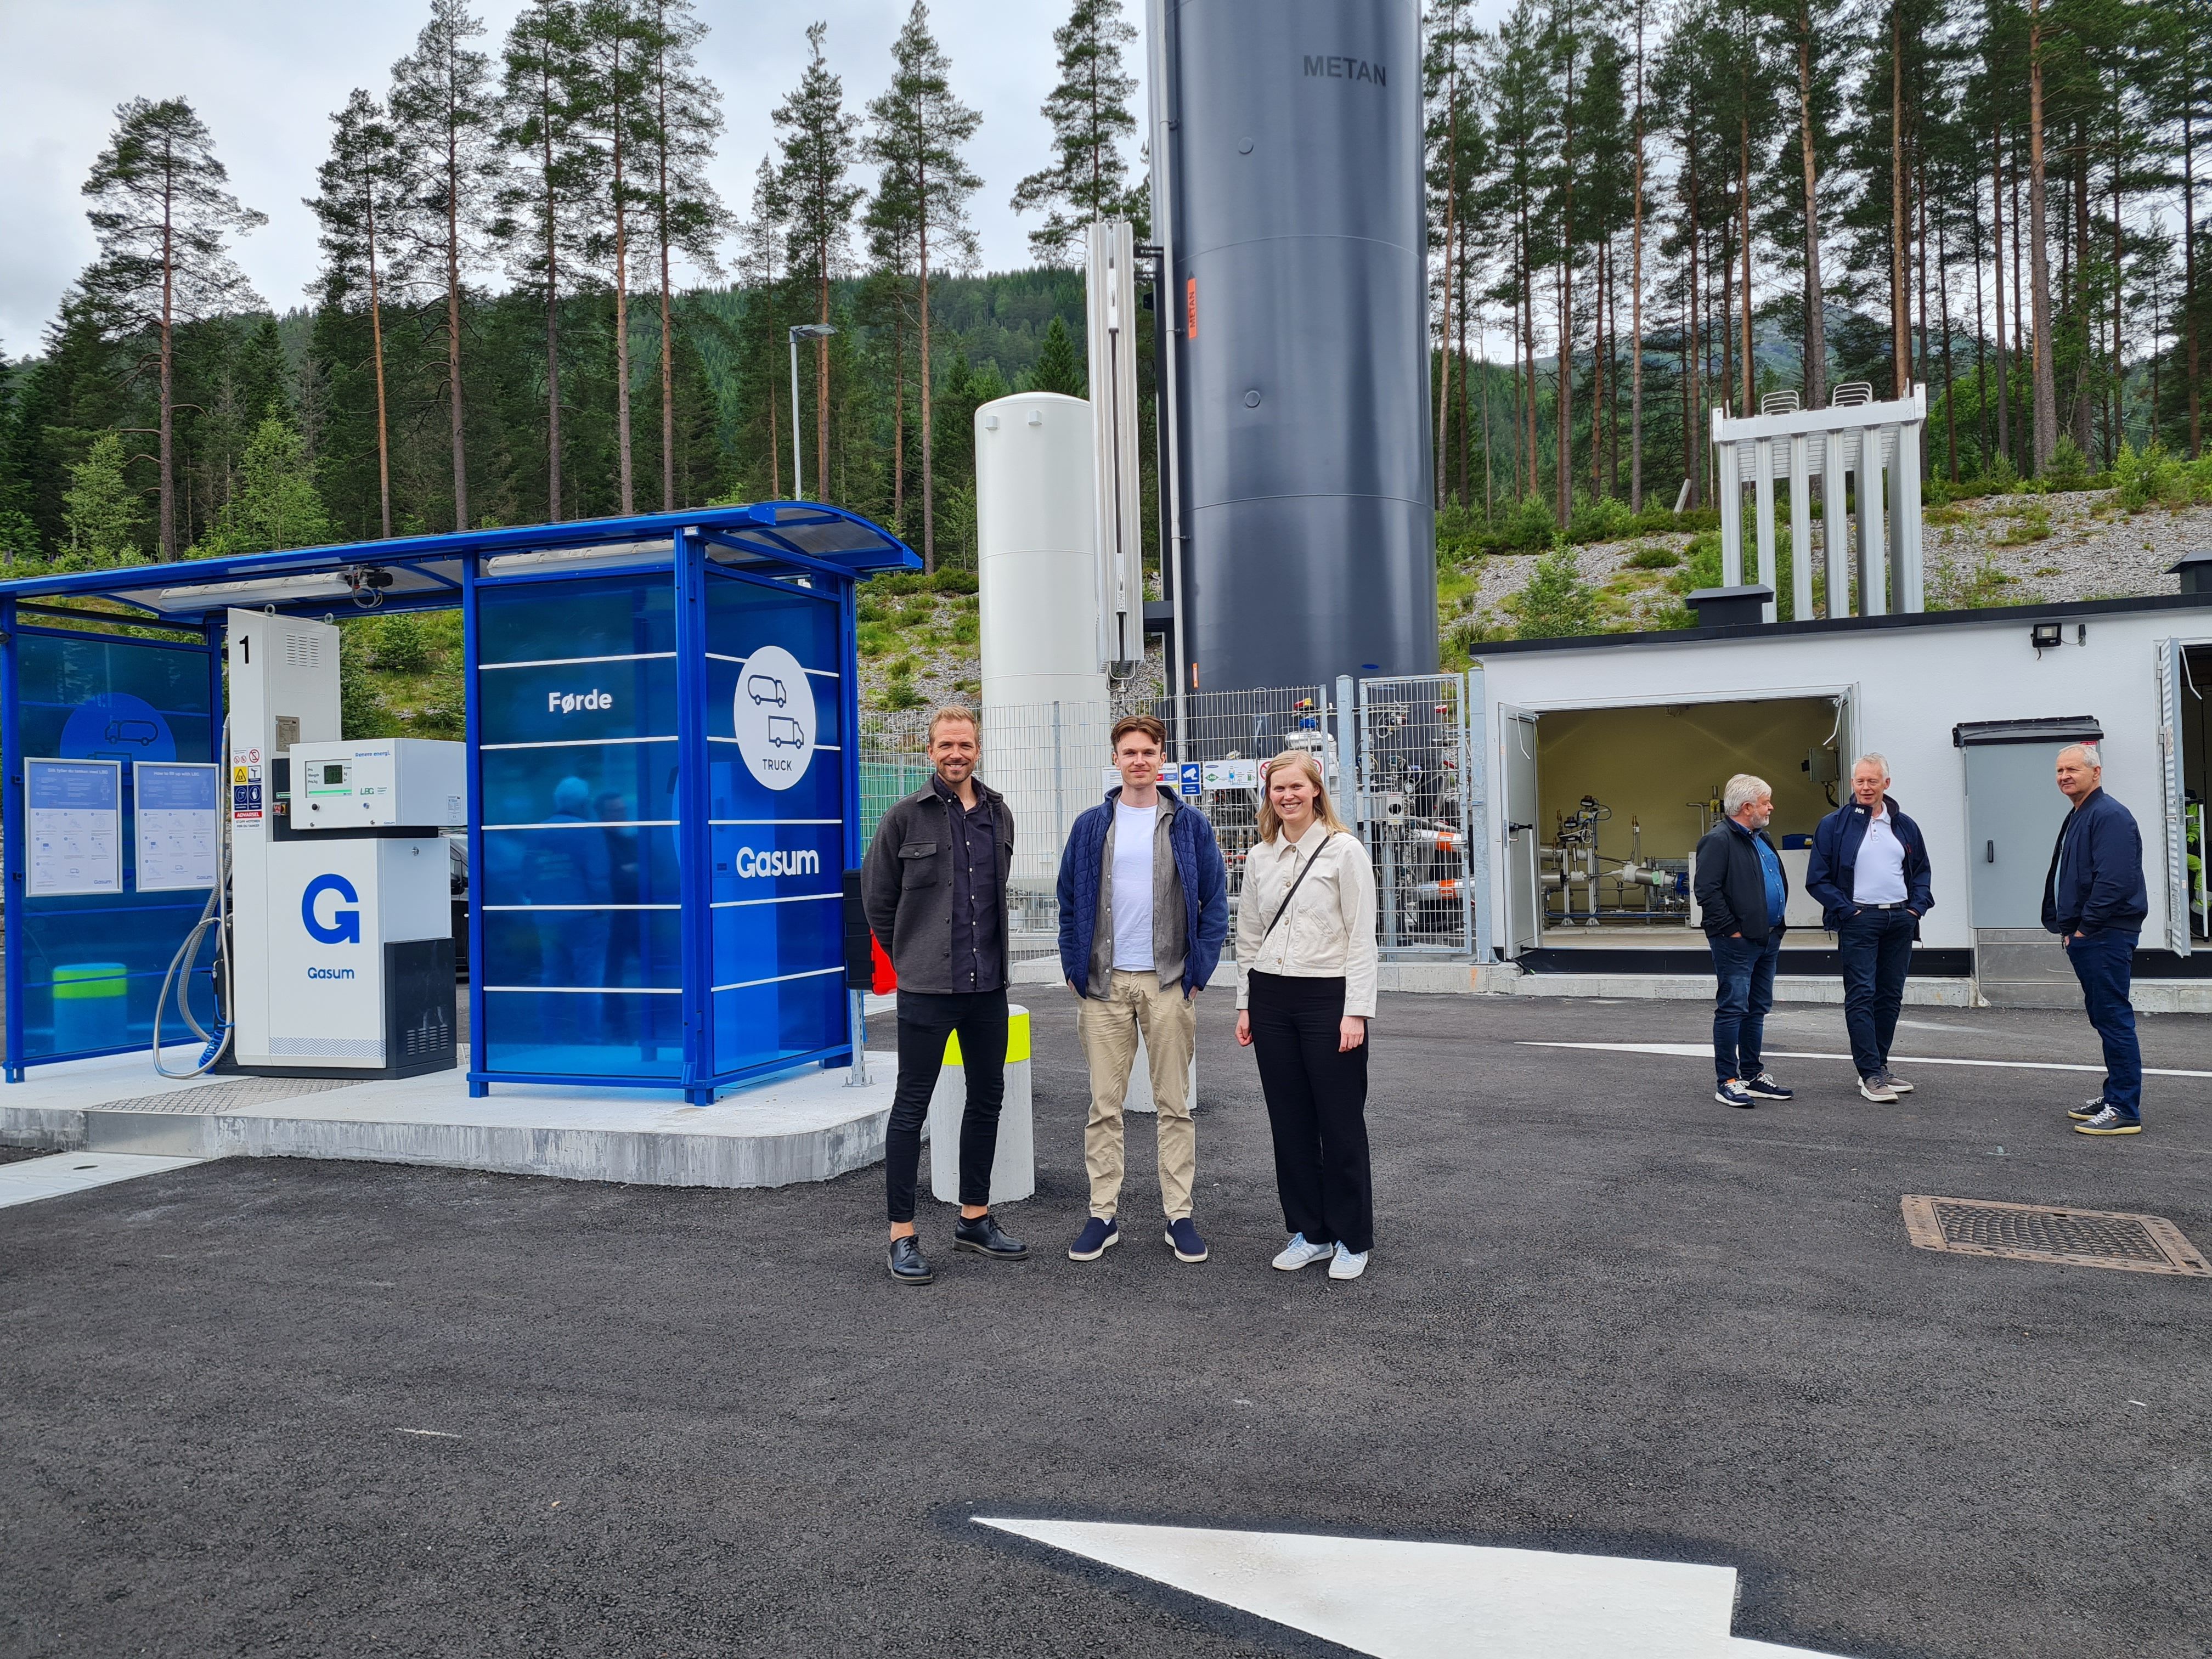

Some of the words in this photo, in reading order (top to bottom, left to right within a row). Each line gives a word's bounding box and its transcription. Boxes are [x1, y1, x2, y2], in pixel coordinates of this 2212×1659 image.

[1304, 55, 1386, 87] METAN
[239, 635, 249, 664] 1
[549, 689, 612, 714] Førde
[762, 759, 792, 772] TRUCK
[360, 787, 375, 795] LBG
[736, 847, 819, 878] Gasum
[302, 873, 360, 944] G
[307, 967, 355, 979] Gasum
